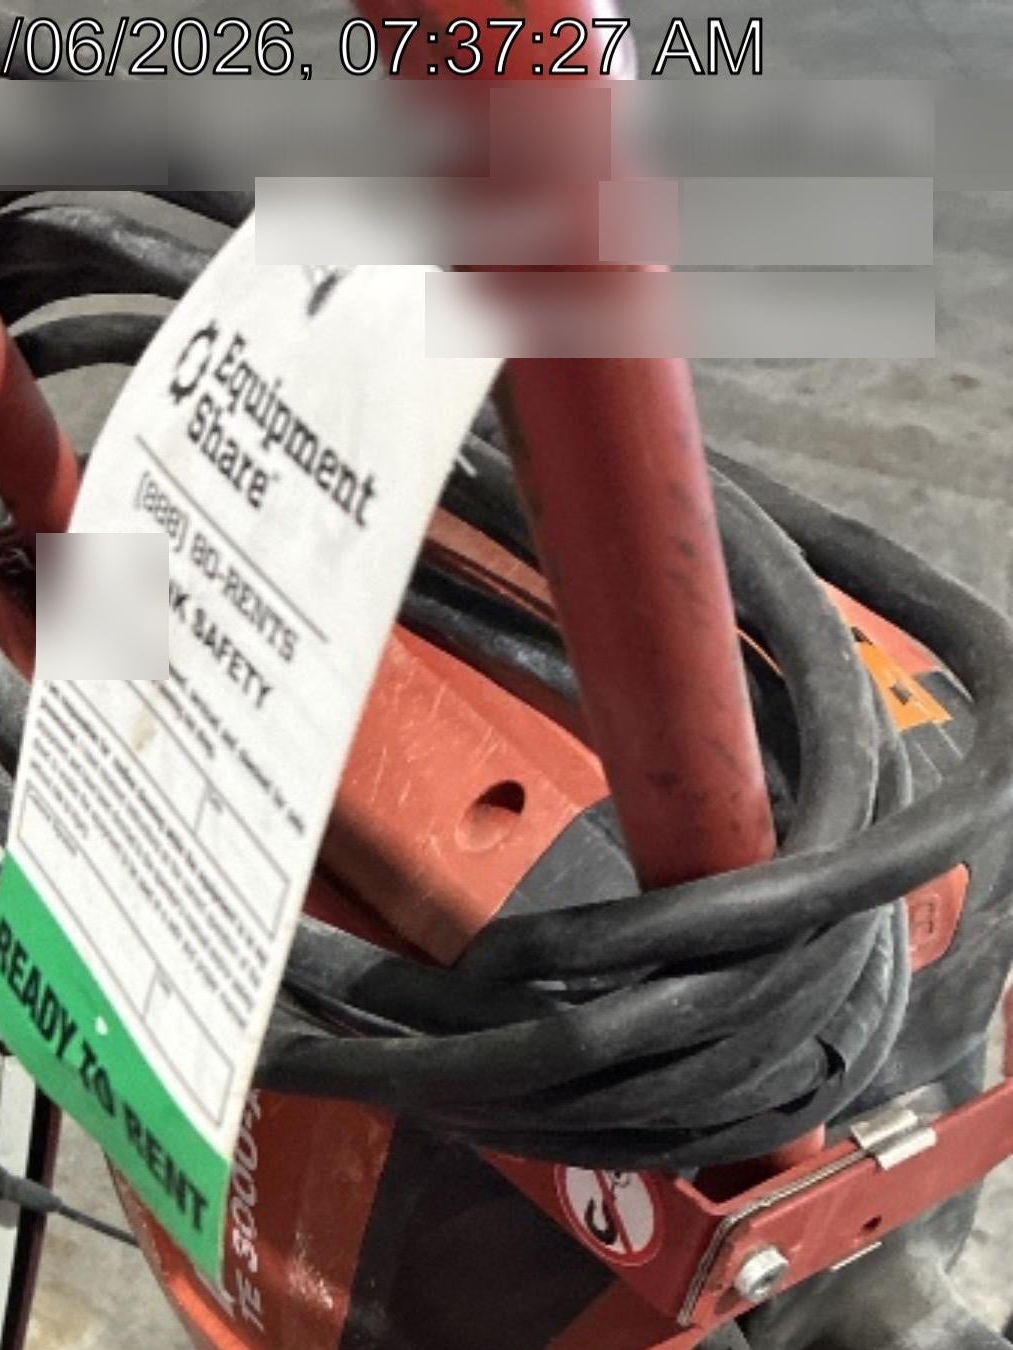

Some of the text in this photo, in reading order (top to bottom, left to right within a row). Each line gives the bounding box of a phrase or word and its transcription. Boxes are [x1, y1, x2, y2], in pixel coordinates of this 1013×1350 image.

[187, 392, 267, 508] Share
[214, 332, 376, 527] Equipment
[134, 470, 190, 553] (888)
[190, 606, 274, 710] SAFETY
[79, 1038, 116, 1119] TO
[122, 1100, 209, 1233] RENT
[235, 1268, 265, 1333] TE
